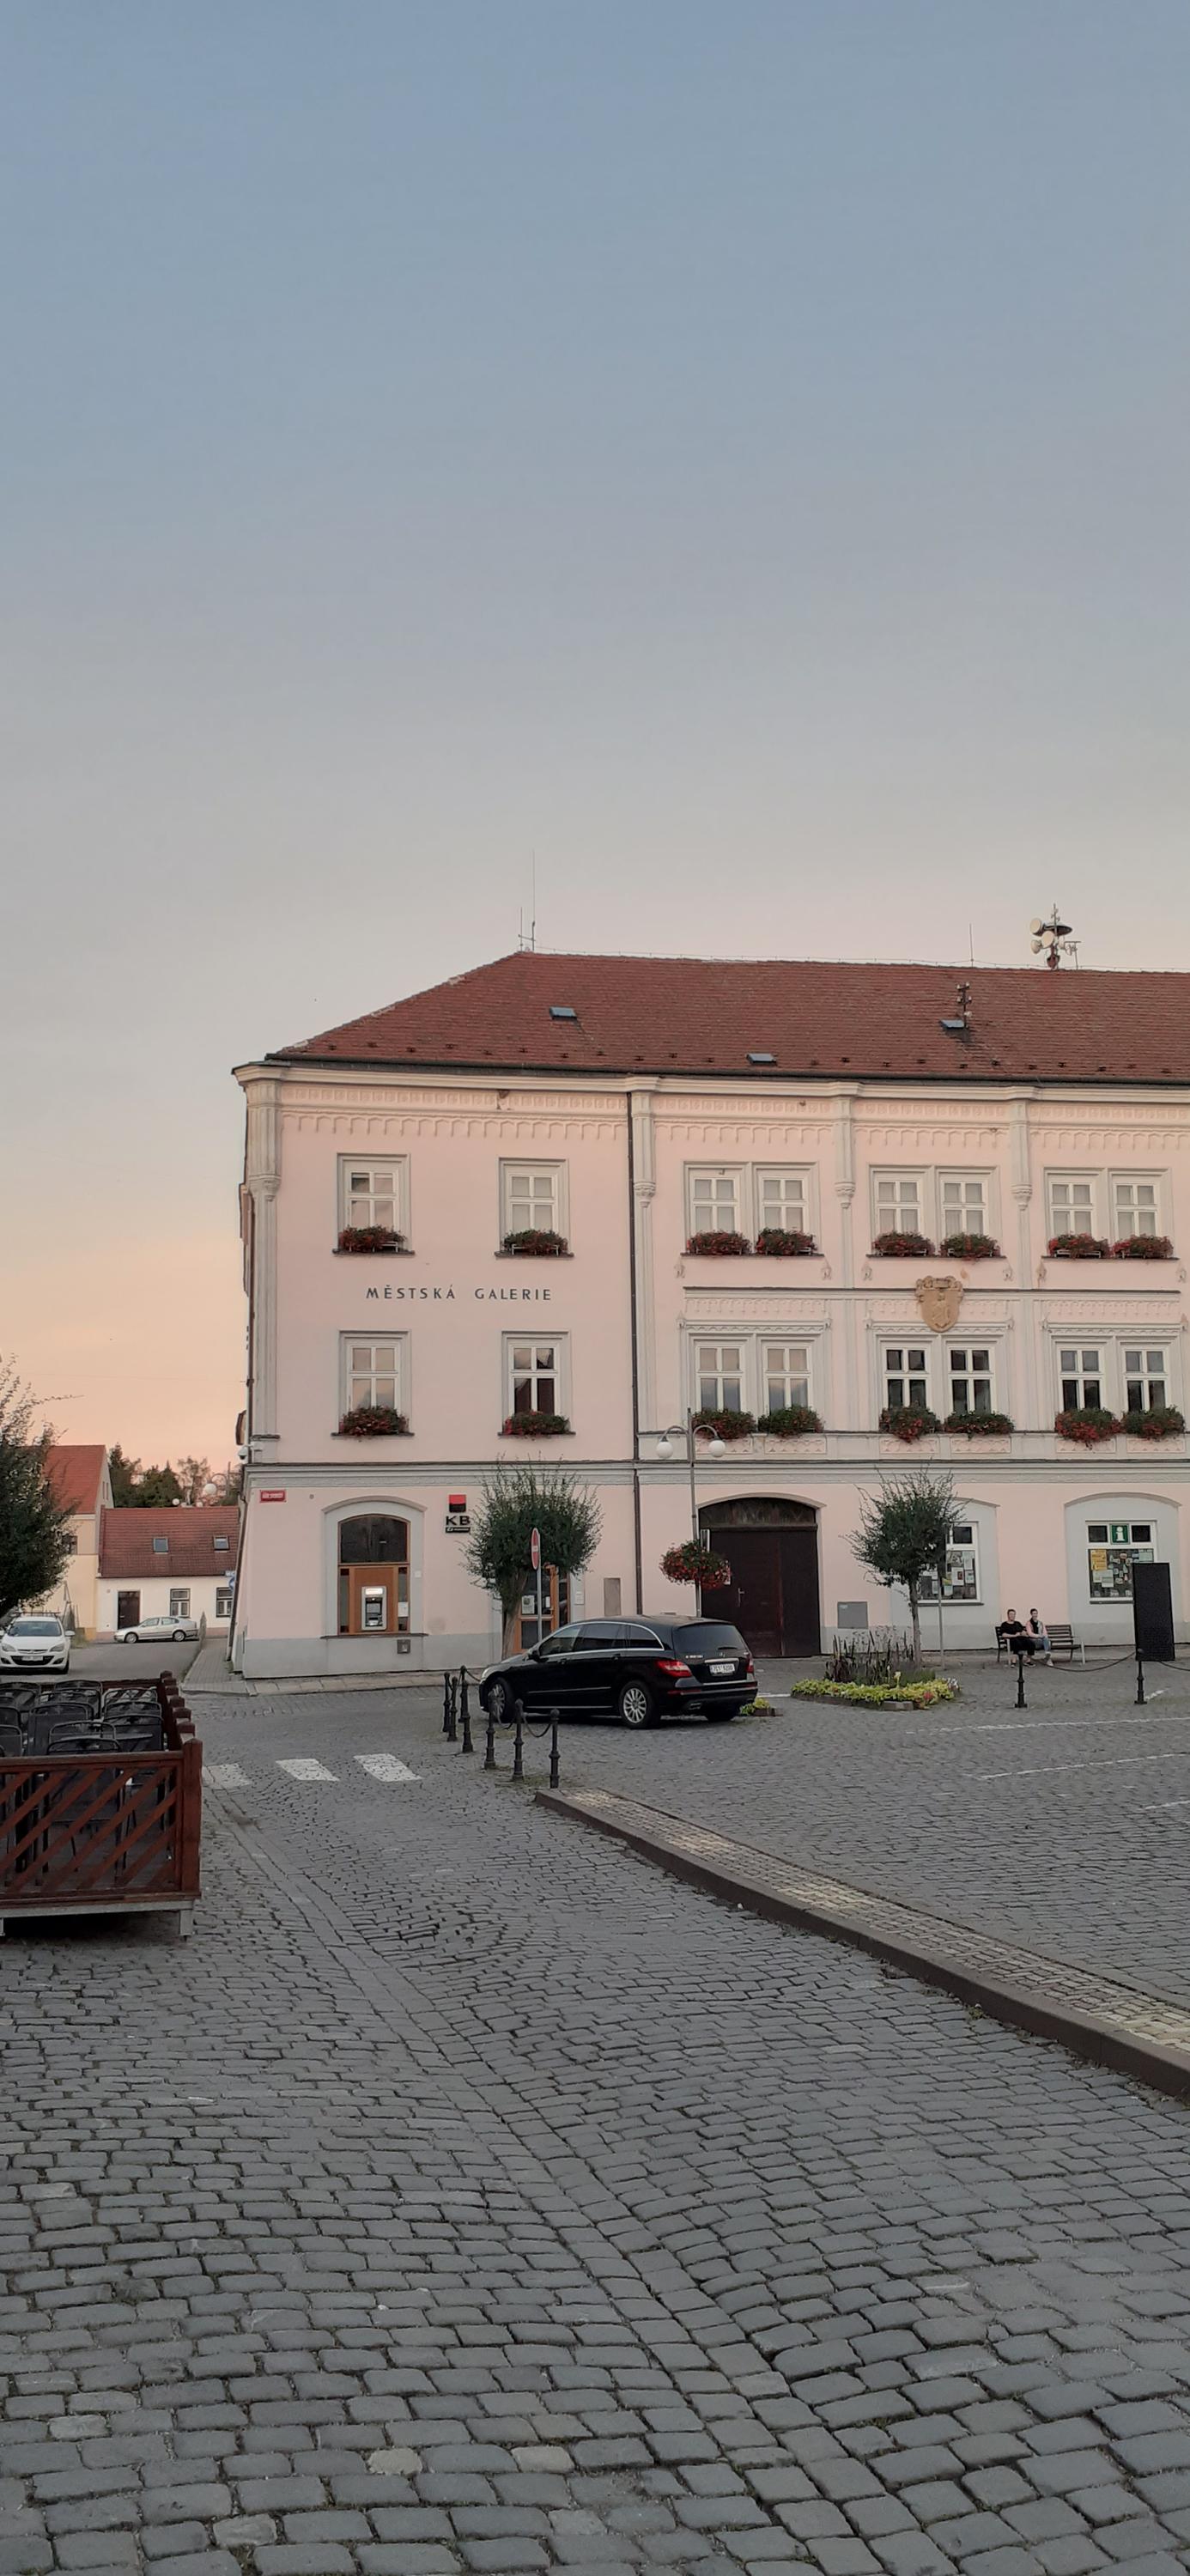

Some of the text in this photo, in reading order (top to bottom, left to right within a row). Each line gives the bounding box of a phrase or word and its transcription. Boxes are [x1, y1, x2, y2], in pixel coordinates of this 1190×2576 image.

[366, 1285, 551, 1300] MĚSTSKÁ GALERIE
[446, 1516, 471, 1526] KB
